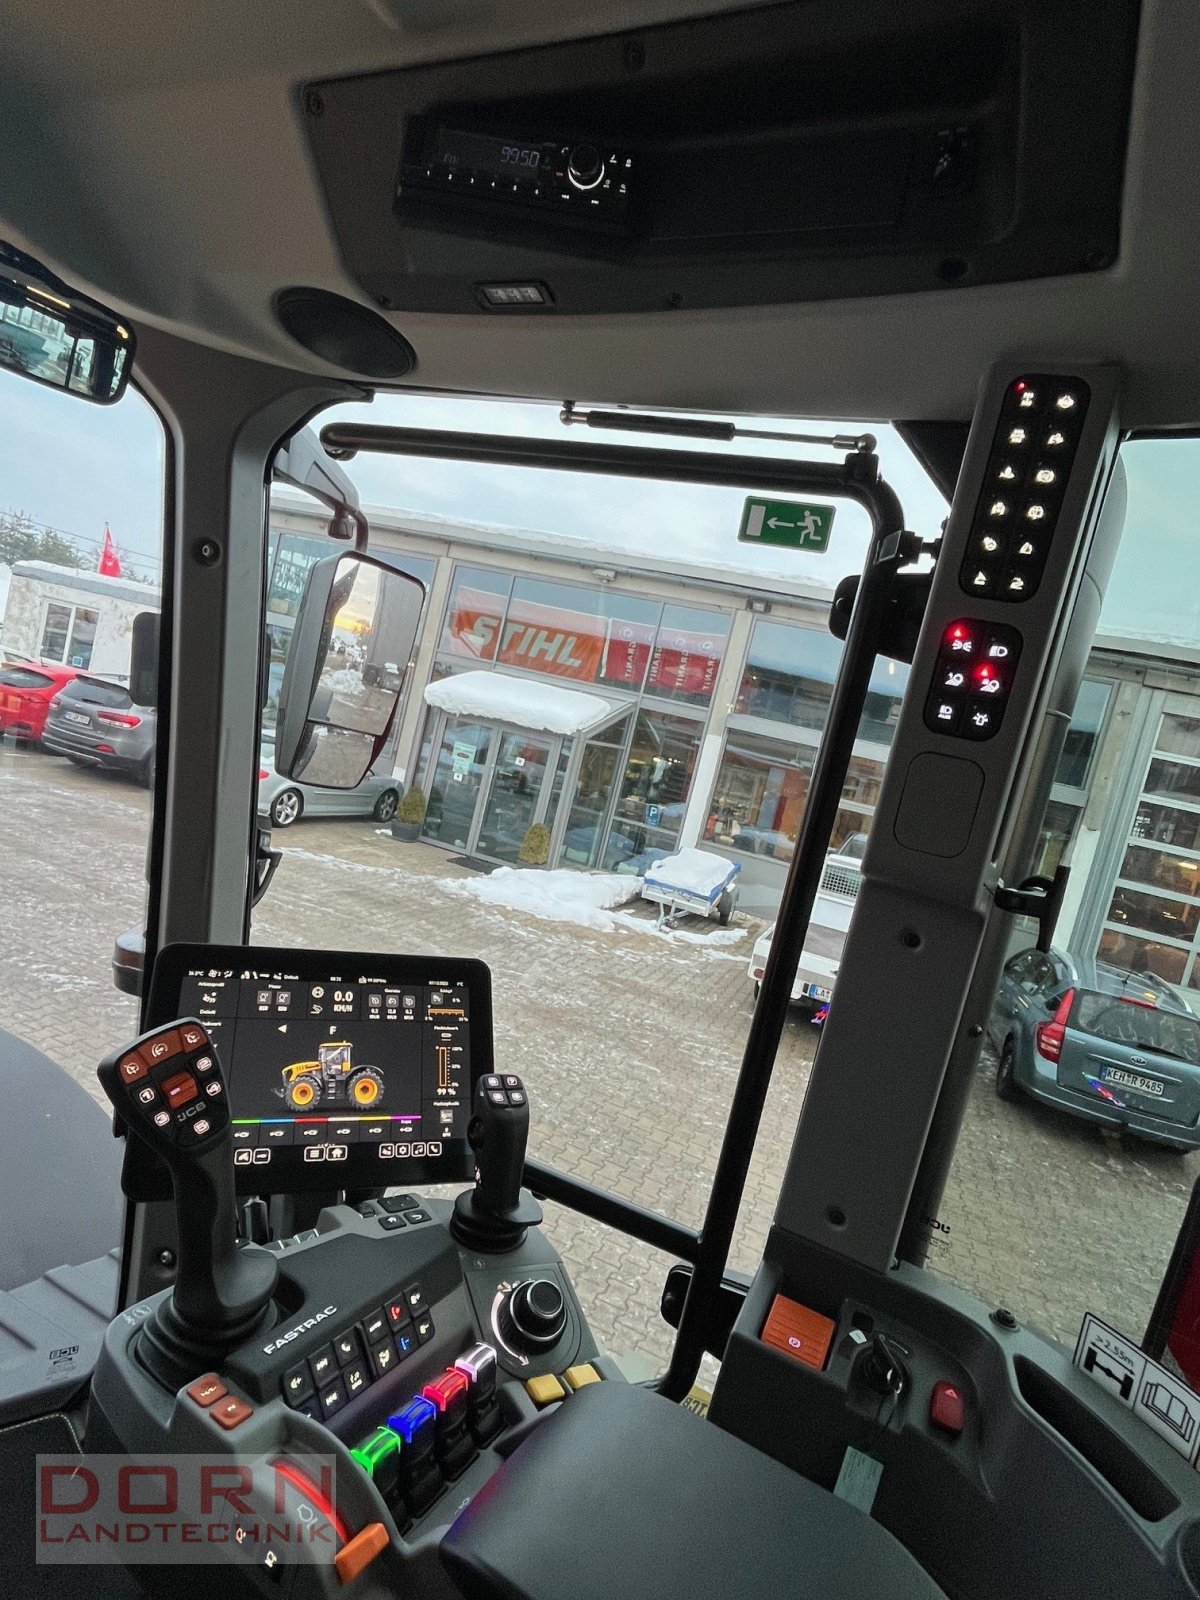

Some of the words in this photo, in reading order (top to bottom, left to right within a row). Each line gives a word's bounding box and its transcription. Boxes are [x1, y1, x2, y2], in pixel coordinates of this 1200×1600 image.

[472, 615, 581, 667] STIHL
[650, 807, 658, 817] P
[333, 990, 354, 1002] 0.0
[333, 1004, 353, 1012] KM/H
[329, 1025, 337, 1035] F
[1107, 1069, 1126, 1082] KEH
[1131, 1076, 1138, 1086] R
[1140, 1079, 1162, 1093] 9485
[177, 1101, 206, 1121] JCB
[262, 1305, 338, 1355] FASTRAC
